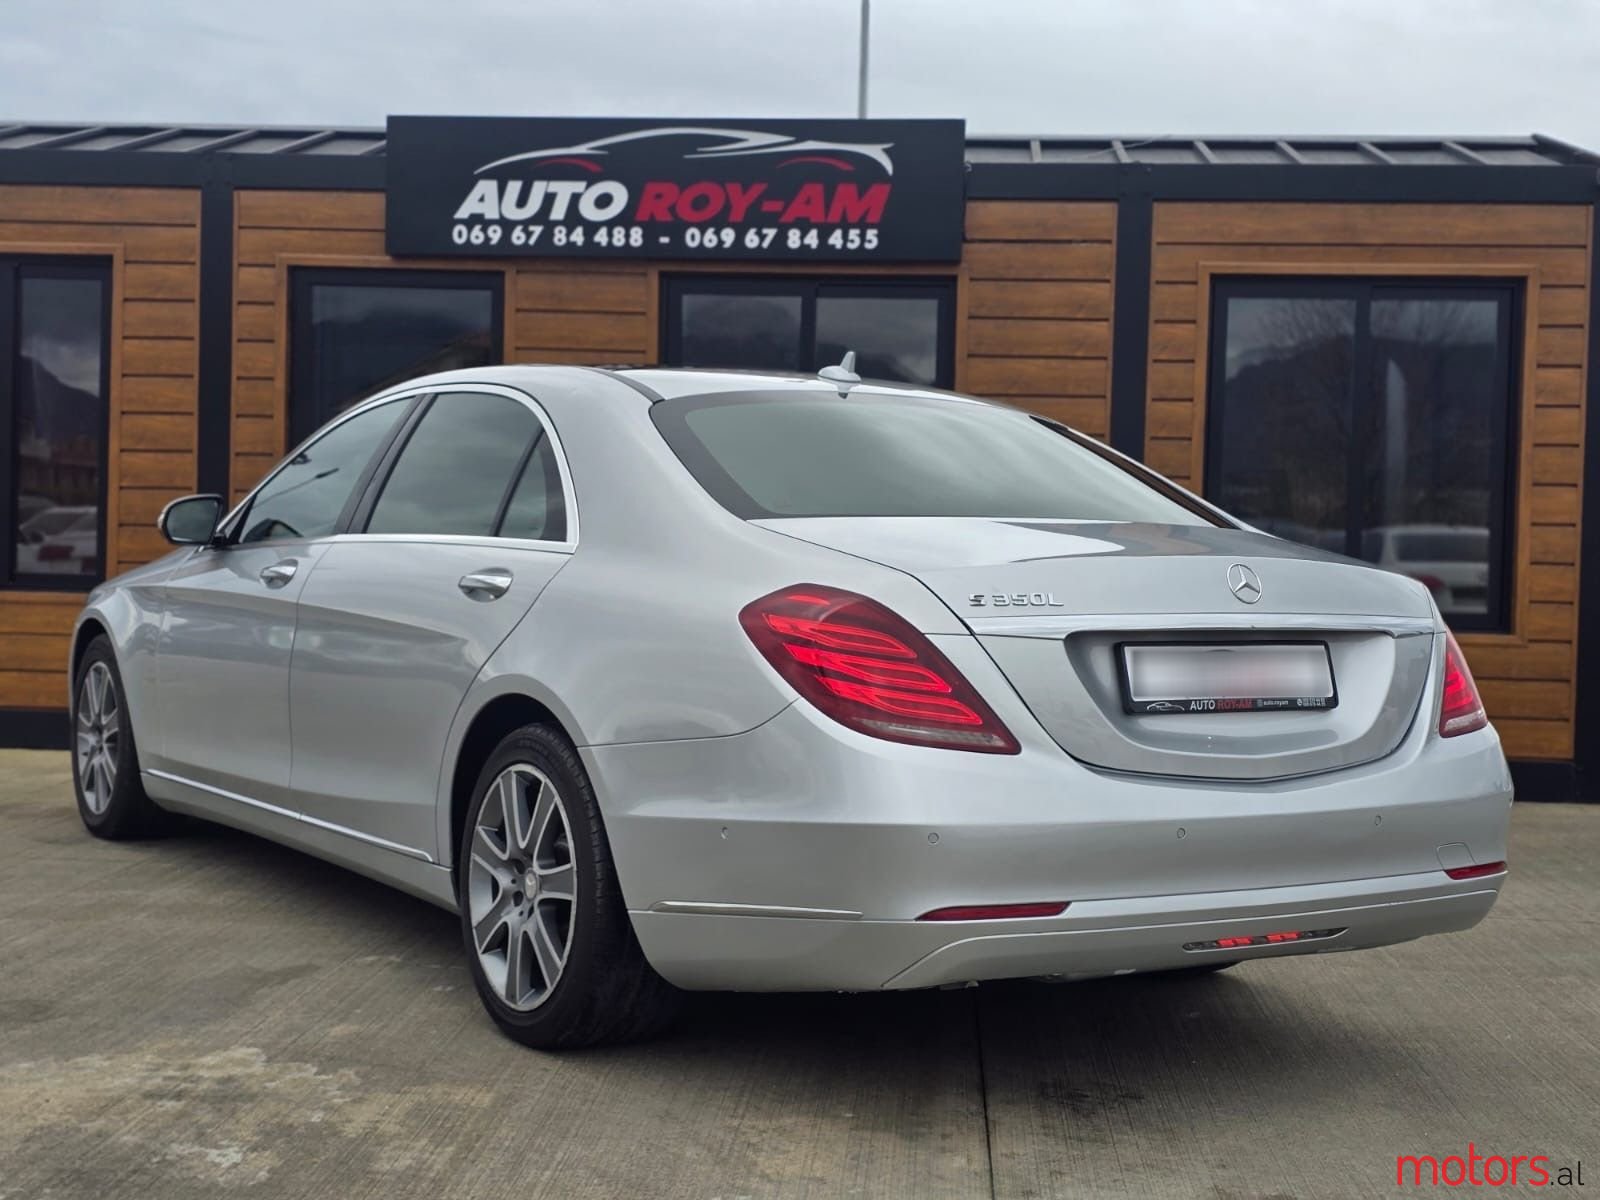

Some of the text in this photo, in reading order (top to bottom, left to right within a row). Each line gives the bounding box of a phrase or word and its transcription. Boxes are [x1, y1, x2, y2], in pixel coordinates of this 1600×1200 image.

[453, 179, 892, 224] AUTO ROY-AM
[452, 223, 502, 245] 069
[511, 225, 544, 246] 67
[553, 225, 585, 247] 84
[593, 226, 643, 248] 488
[685, 227, 736, 248] 069
[744, 227, 778, 249] 67
[786, 228, 819, 249] 84
[827, 228, 879, 250] 455
[968, 592, 1065, 607] S 350L
[1189, 700, 1216, 711] AUTO
[1217, 698, 1254, 710] ROY-AM
